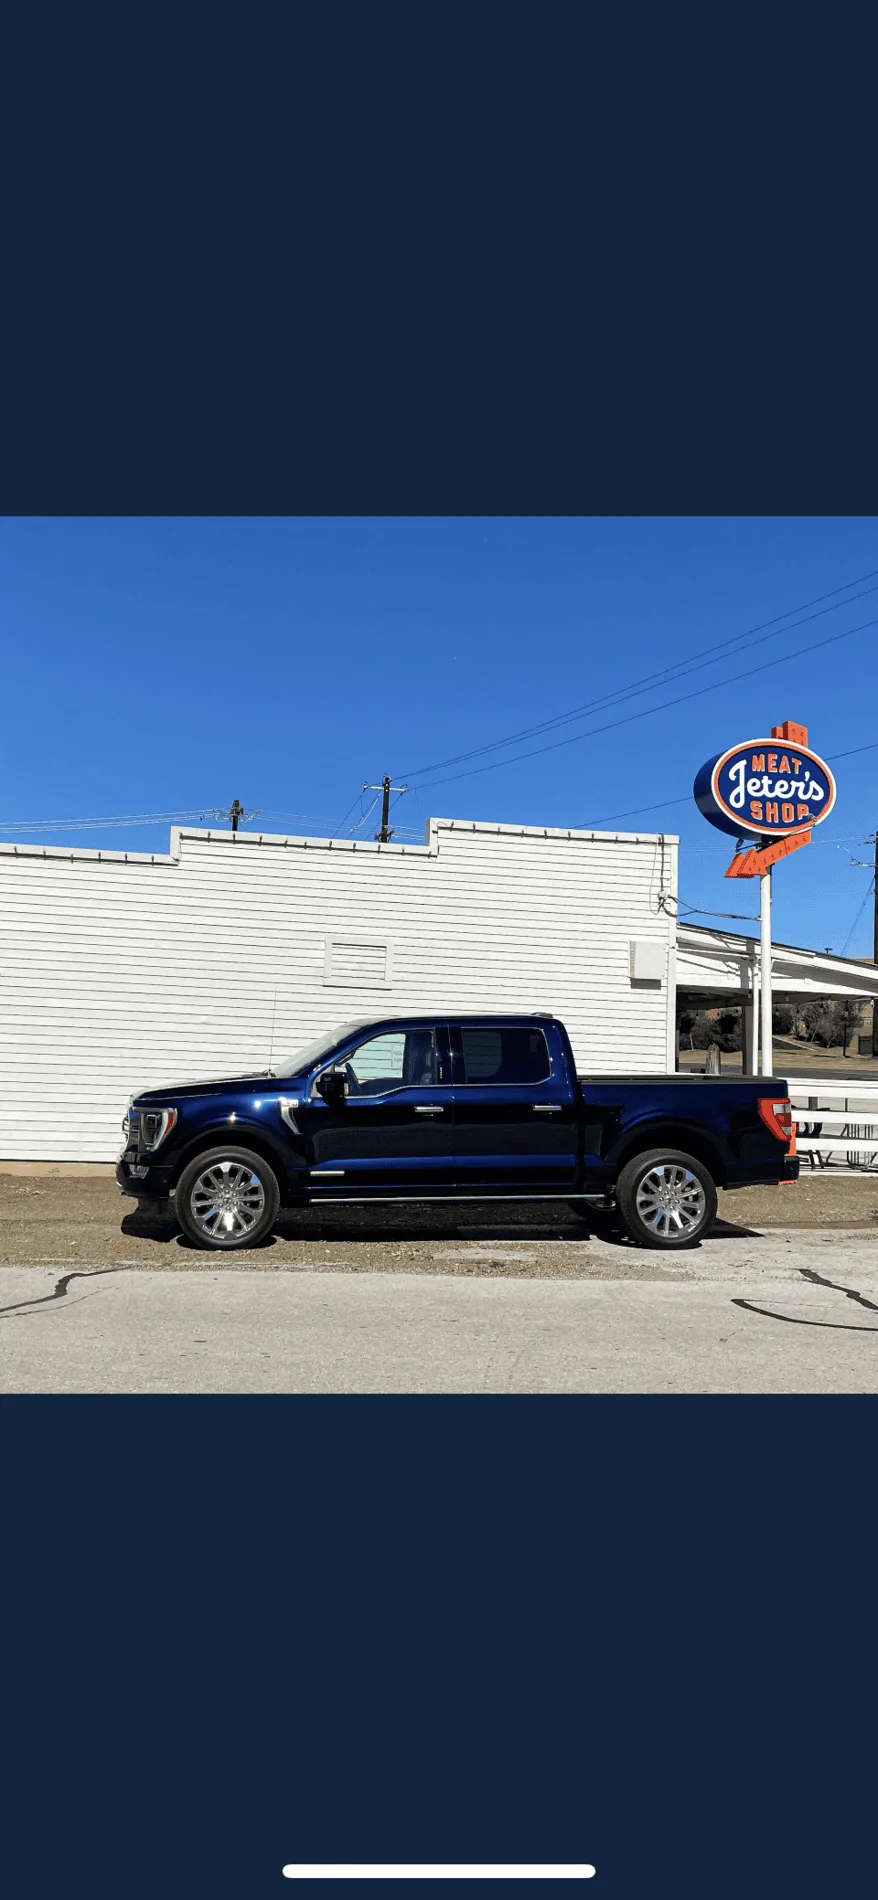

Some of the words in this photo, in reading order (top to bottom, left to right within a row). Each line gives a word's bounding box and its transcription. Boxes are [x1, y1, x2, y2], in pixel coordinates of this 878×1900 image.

[752, 753, 802, 775] MEAT
[728, 759, 825, 809] Jeter's
[749, 800, 809, 823] SHOP
